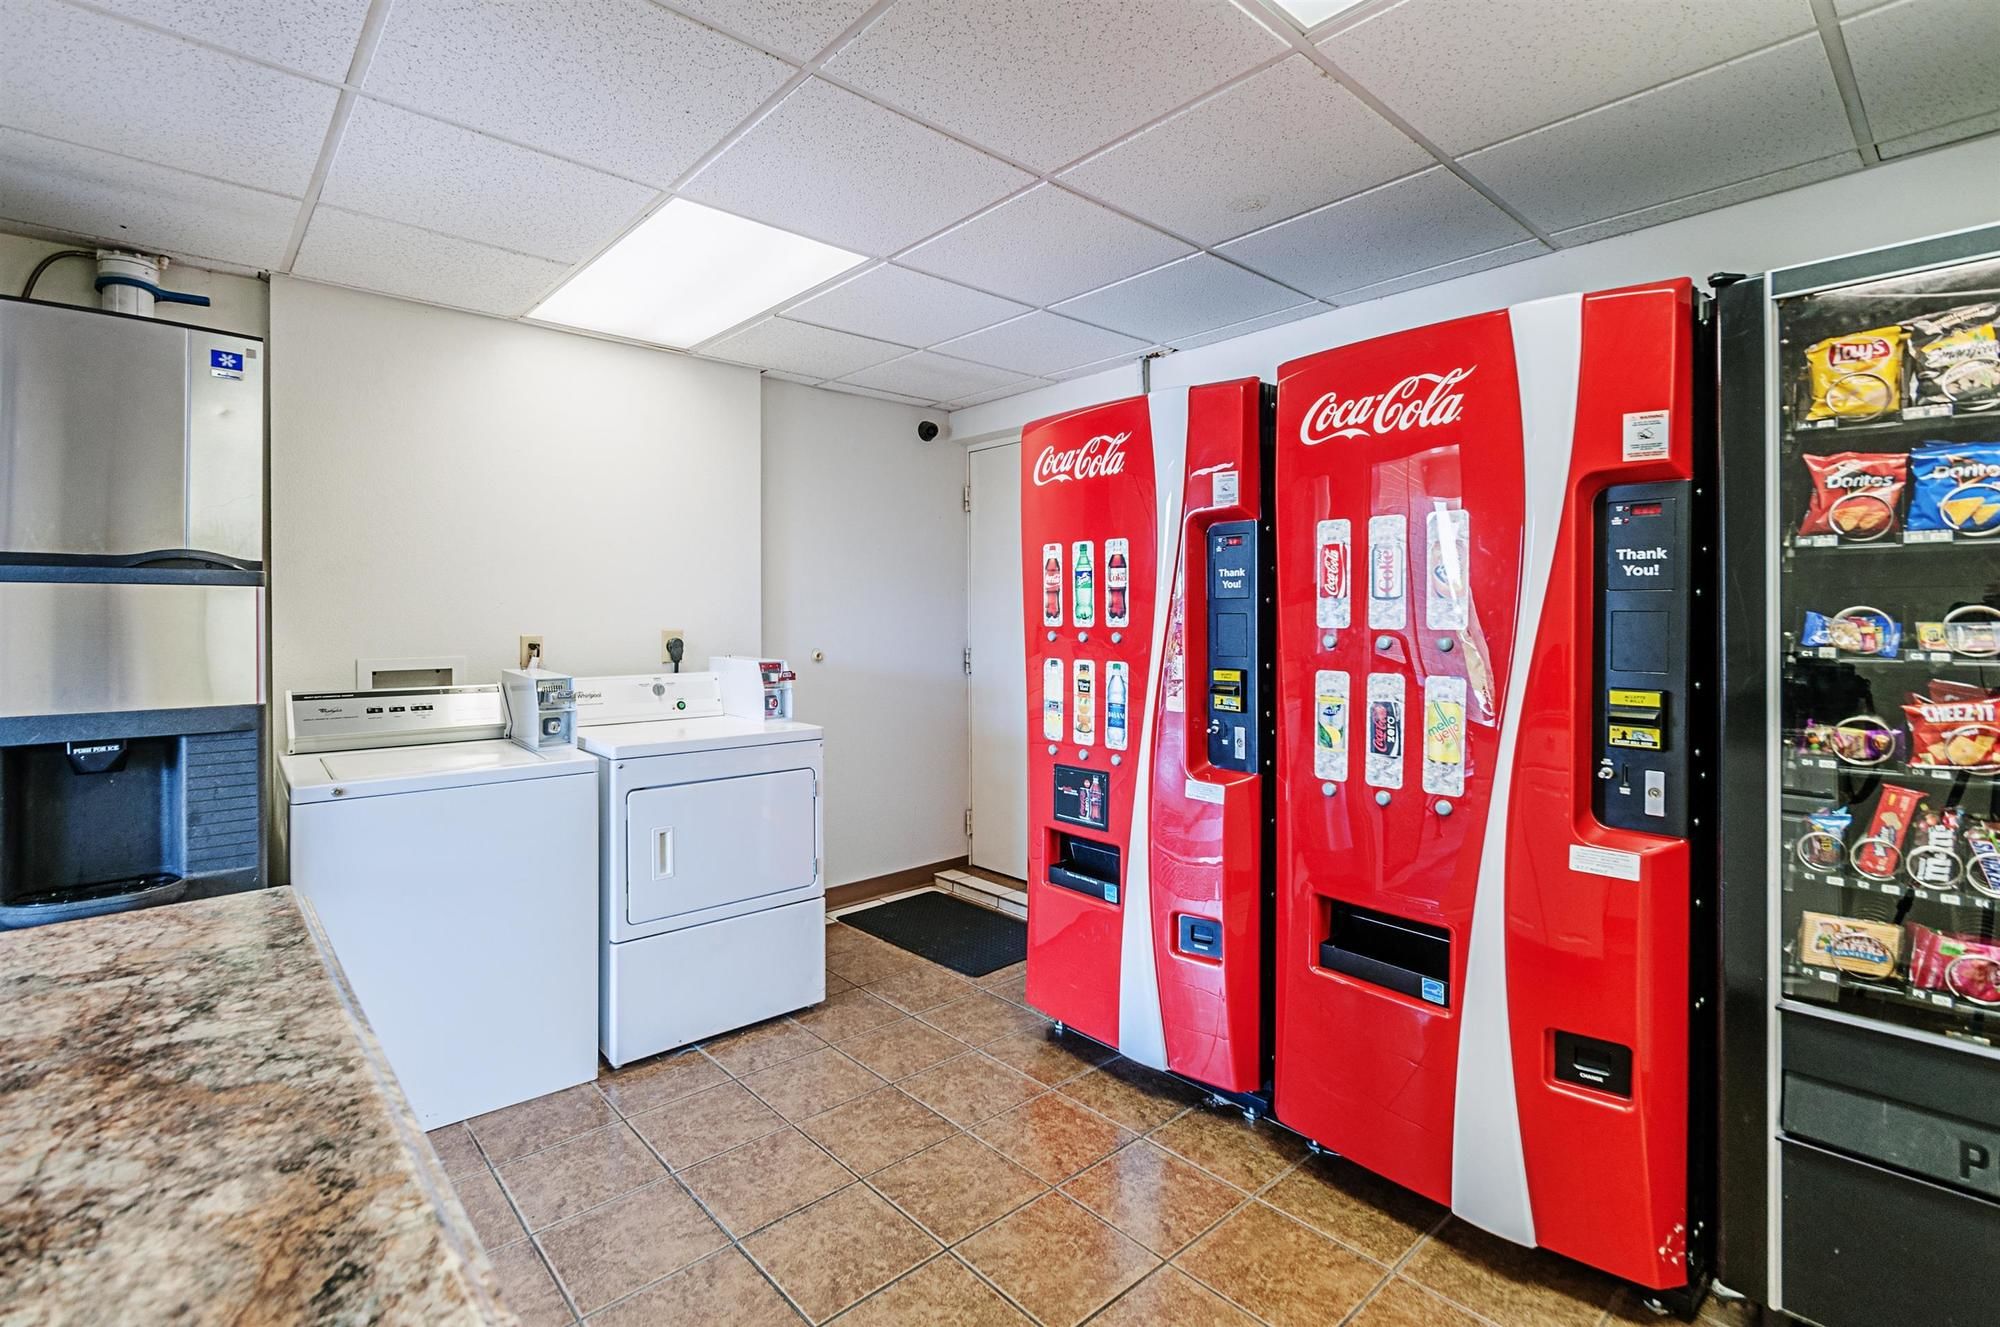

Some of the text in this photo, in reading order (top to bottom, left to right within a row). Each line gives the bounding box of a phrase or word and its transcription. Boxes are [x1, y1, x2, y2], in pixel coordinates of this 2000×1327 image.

[1300, 364, 1478, 445] Coca-Cola
[1033, 431, 1132, 486] Coca-Cola
[1933, 463, 2000, 479] Dorito
[1825, 474, 1894, 488] Doritos
[1615, 547, 1668, 560] Thank
[1218, 567, 1246, 577] Thank
[1324, 548, 1339, 596] Coca-Cola
[1379, 550, 1394, 592] Coke
[1622, 564, 1660, 576] You!
[1222, 580, 1242, 589] You!
[1373, 704, 1388, 752] Coca-Cola
[1387, 716, 1396, 743] zero
[1428, 703, 1456, 736] mello
